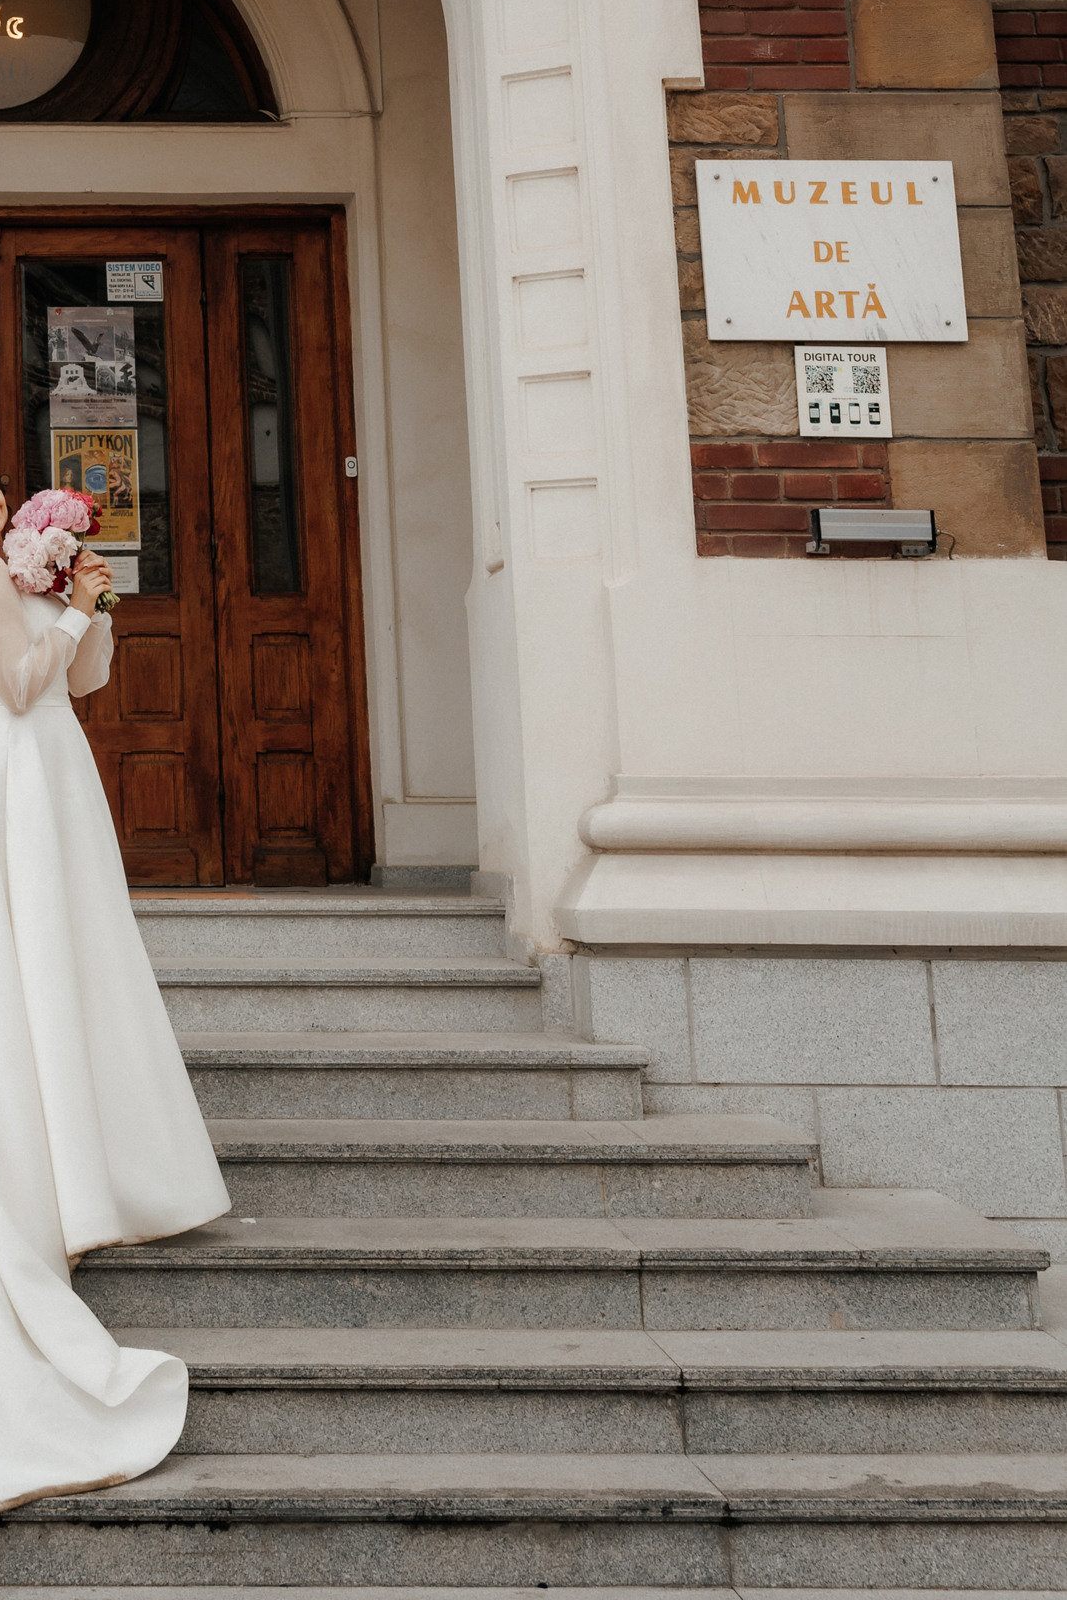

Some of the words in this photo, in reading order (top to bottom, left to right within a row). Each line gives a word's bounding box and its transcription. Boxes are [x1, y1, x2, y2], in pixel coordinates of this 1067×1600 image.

[732, 180, 923, 205] MUZEUL
[813, 240, 850, 263] DE
[108, 263, 135, 271] SISTEM
[138, 263, 160, 271] VIDEO
[786, 283, 887, 319] ARTĂ
[804, 353, 844, 361] DIGITAL
[847, 353, 876, 362] TOUR
[56, 434, 133, 459] TRIPTYKON
